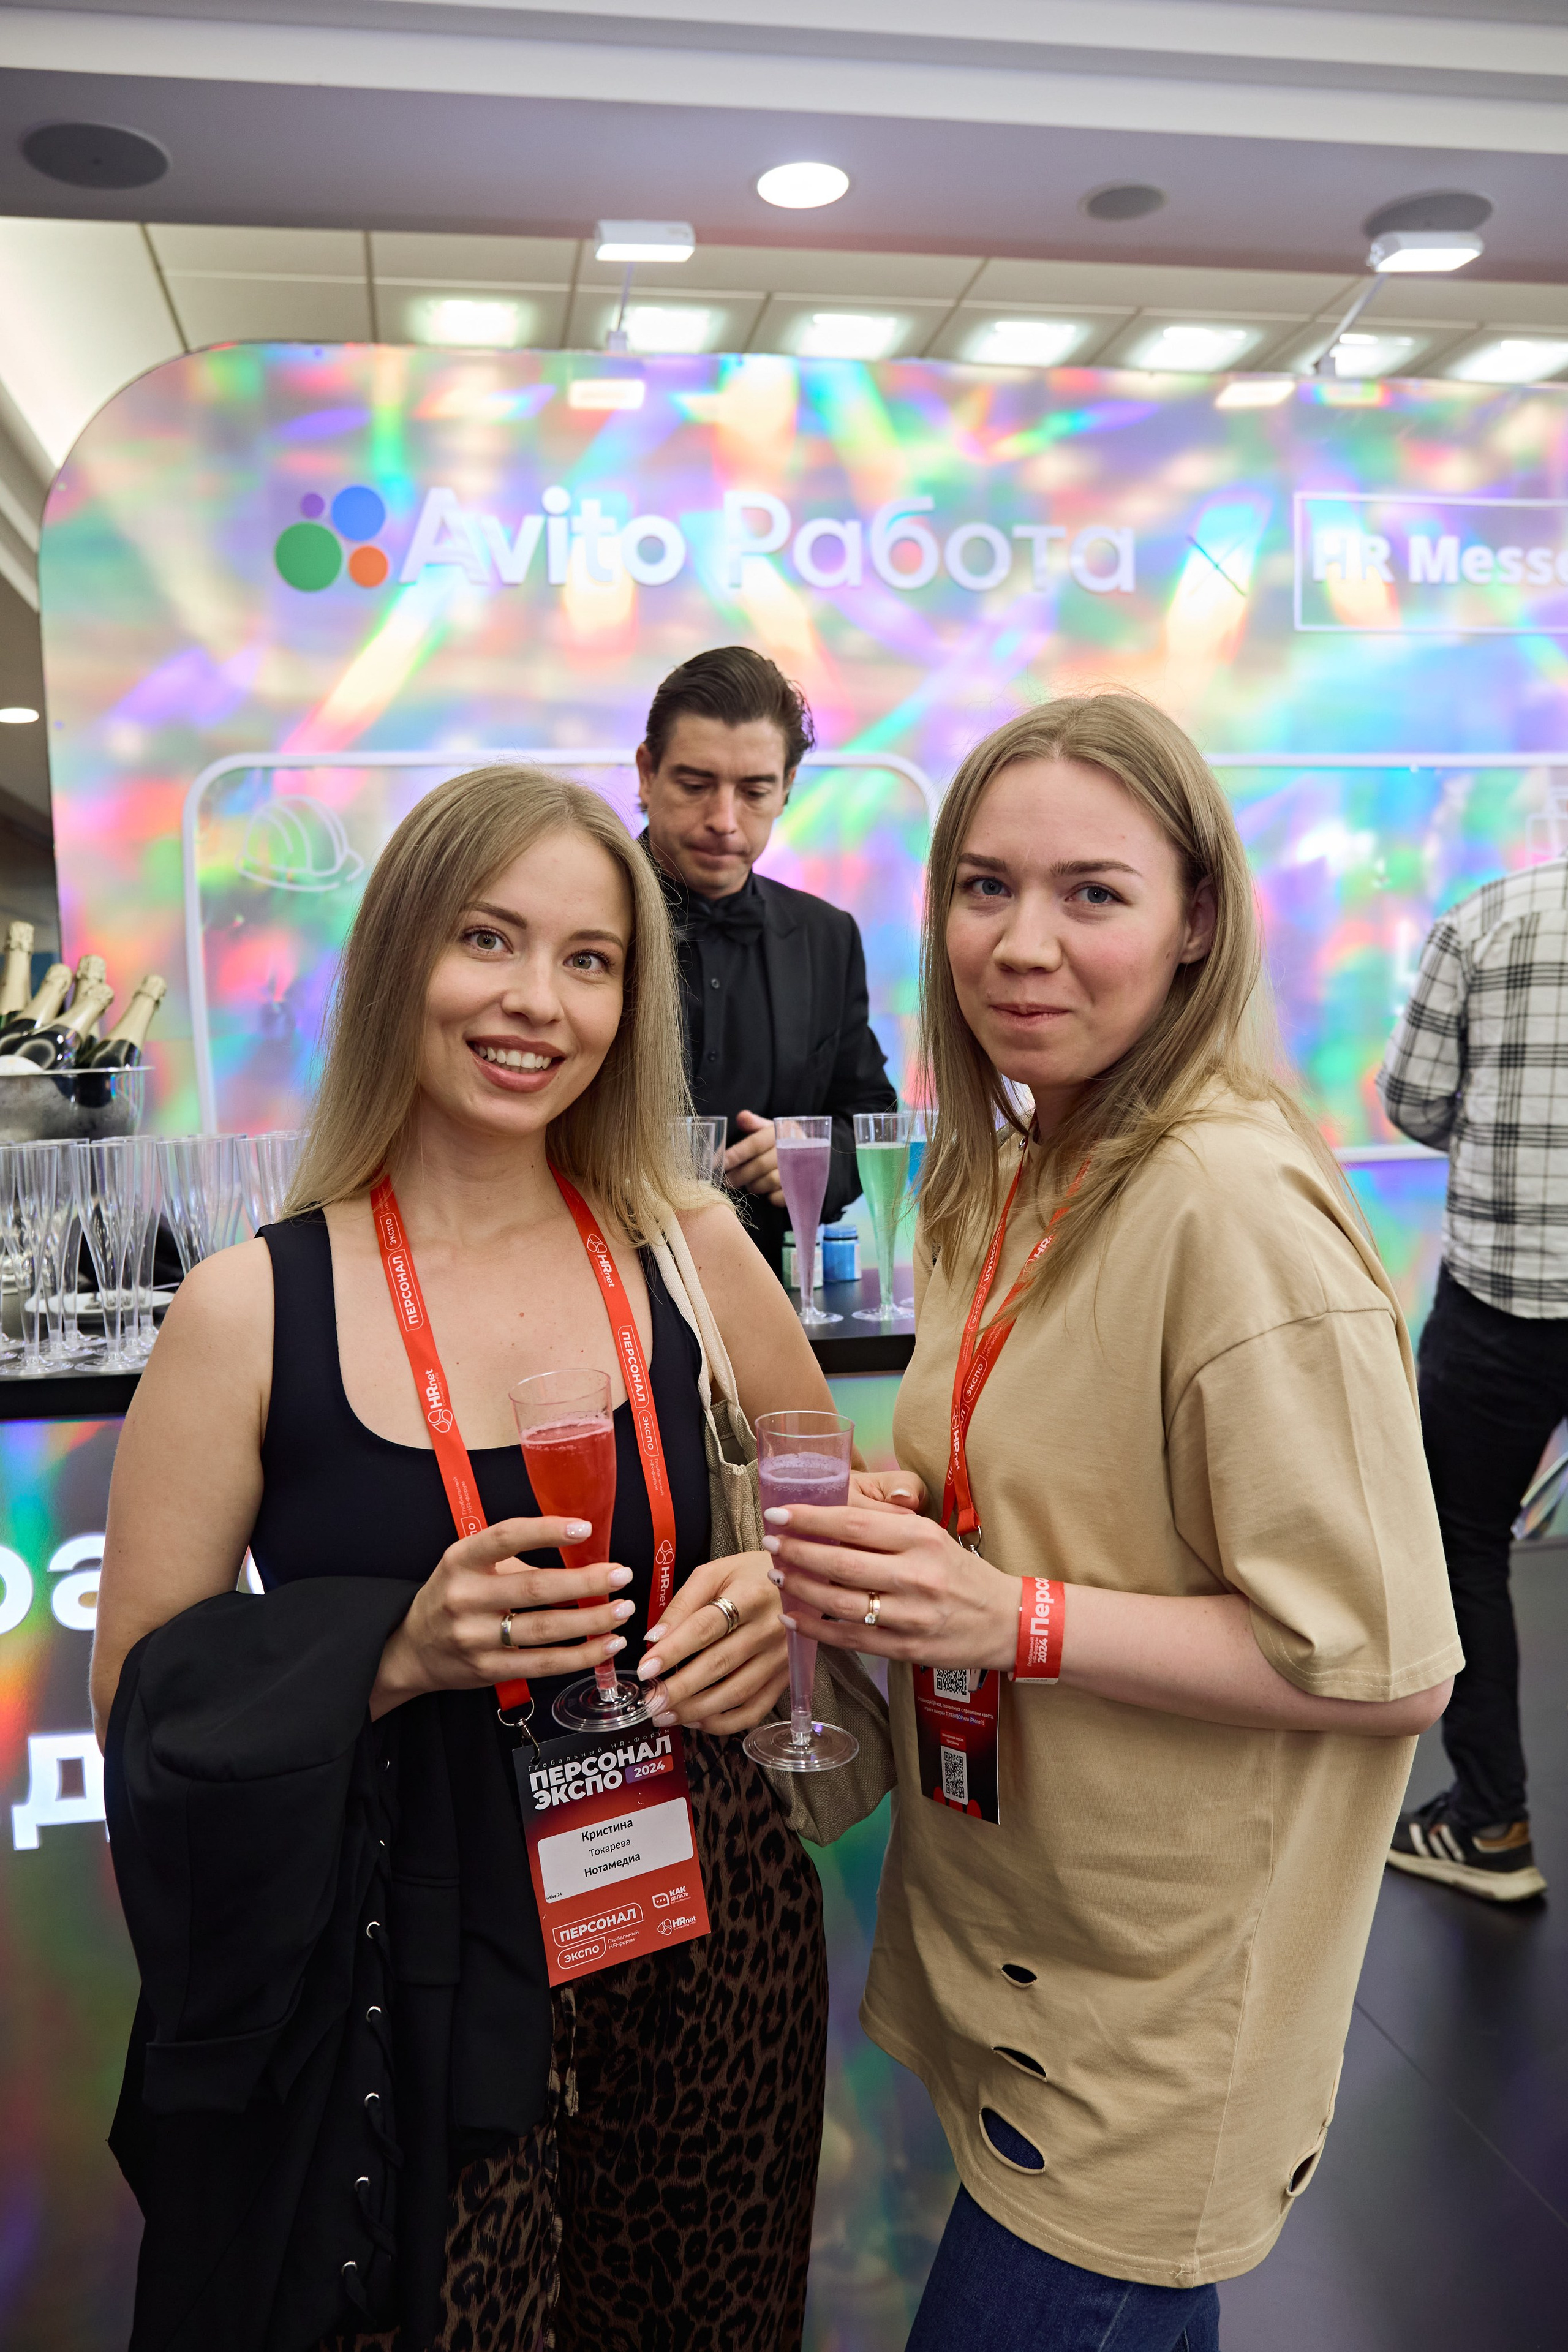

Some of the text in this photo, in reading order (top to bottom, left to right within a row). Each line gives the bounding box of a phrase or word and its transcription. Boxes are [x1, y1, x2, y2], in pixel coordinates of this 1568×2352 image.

[399, 485, 1134, 593] Avito Работа
[1312, 533, 1395, 583] HR
[385, 1218, 397, 1245] ЭКСПО
[597, 1254, 615, 1287] HRnet
[392, 1256, 419, 1325] ПЕРСОНАЛ
[971, 1293, 982, 1323] ЭКСПО
[622, 1332, 646, 1402] ПЕРСОНАЛ
[966, 1363, 983, 1396] ЭКСПО
[425, 1368, 443, 1409] HRnet
[643, 1416, 654, 1450] ЭКСПО
[659, 1566, 670, 1607] HRnet
[1037, 1638, 1048, 1663] 2024
[528, 1729, 670, 1772] Глобальный HR-Форум
[529, 1735, 672, 1792] ПЕРСОНАЛ
[533, 1760, 665, 1811] ЭКСПО 2024
[581, 1820, 633, 1842] Кристина
[589, 1839, 631, 1857] Токарева
[584, 1853, 641, 1877] Нотамедиа
[669, 1885, 686, 1897] КАК
[671, 1892, 689, 1902] ДЕЛАТЬ
[560, 1907, 636, 1942] ПЕРСОНАЛ
[608, 1930, 639, 1944] Глобальный
[672, 1915, 696, 1928] HRnet
[564, 1945, 600, 1963] ЭКСПО
[608, 1938, 635, 1950] HR-форум
